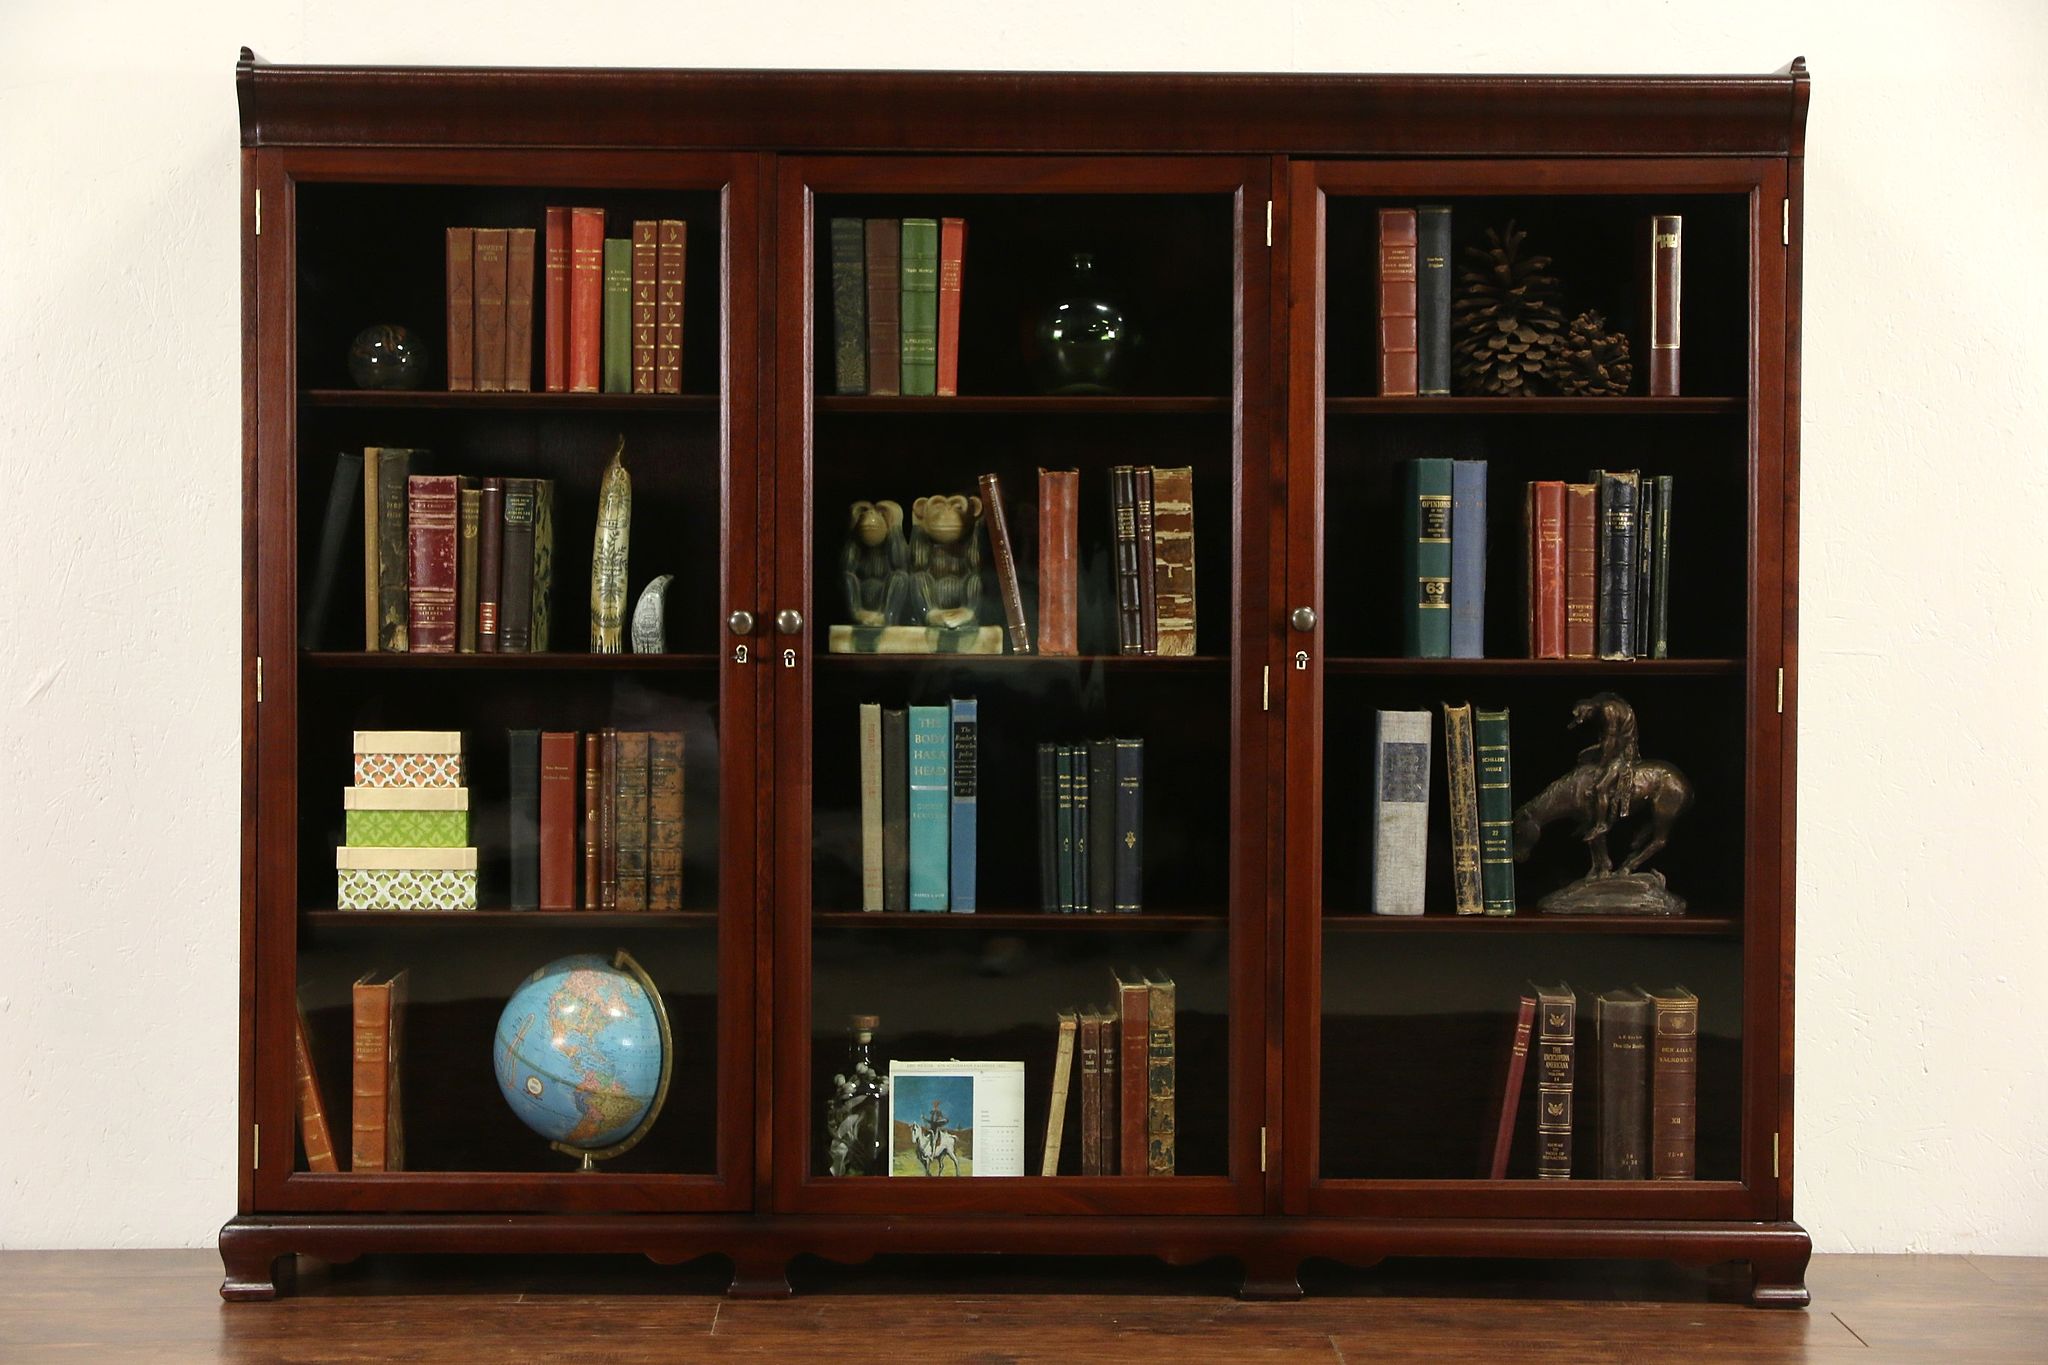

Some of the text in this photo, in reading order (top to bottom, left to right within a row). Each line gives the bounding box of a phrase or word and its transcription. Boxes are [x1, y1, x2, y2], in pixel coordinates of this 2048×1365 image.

[1422, 500, 1452, 508] OPINIONS
[1426, 583, 1445, 594] 63
[920, 719, 942, 728] THE
[915, 734, 946, 743] BODY
[914, 766, 946, 776] HEAD
